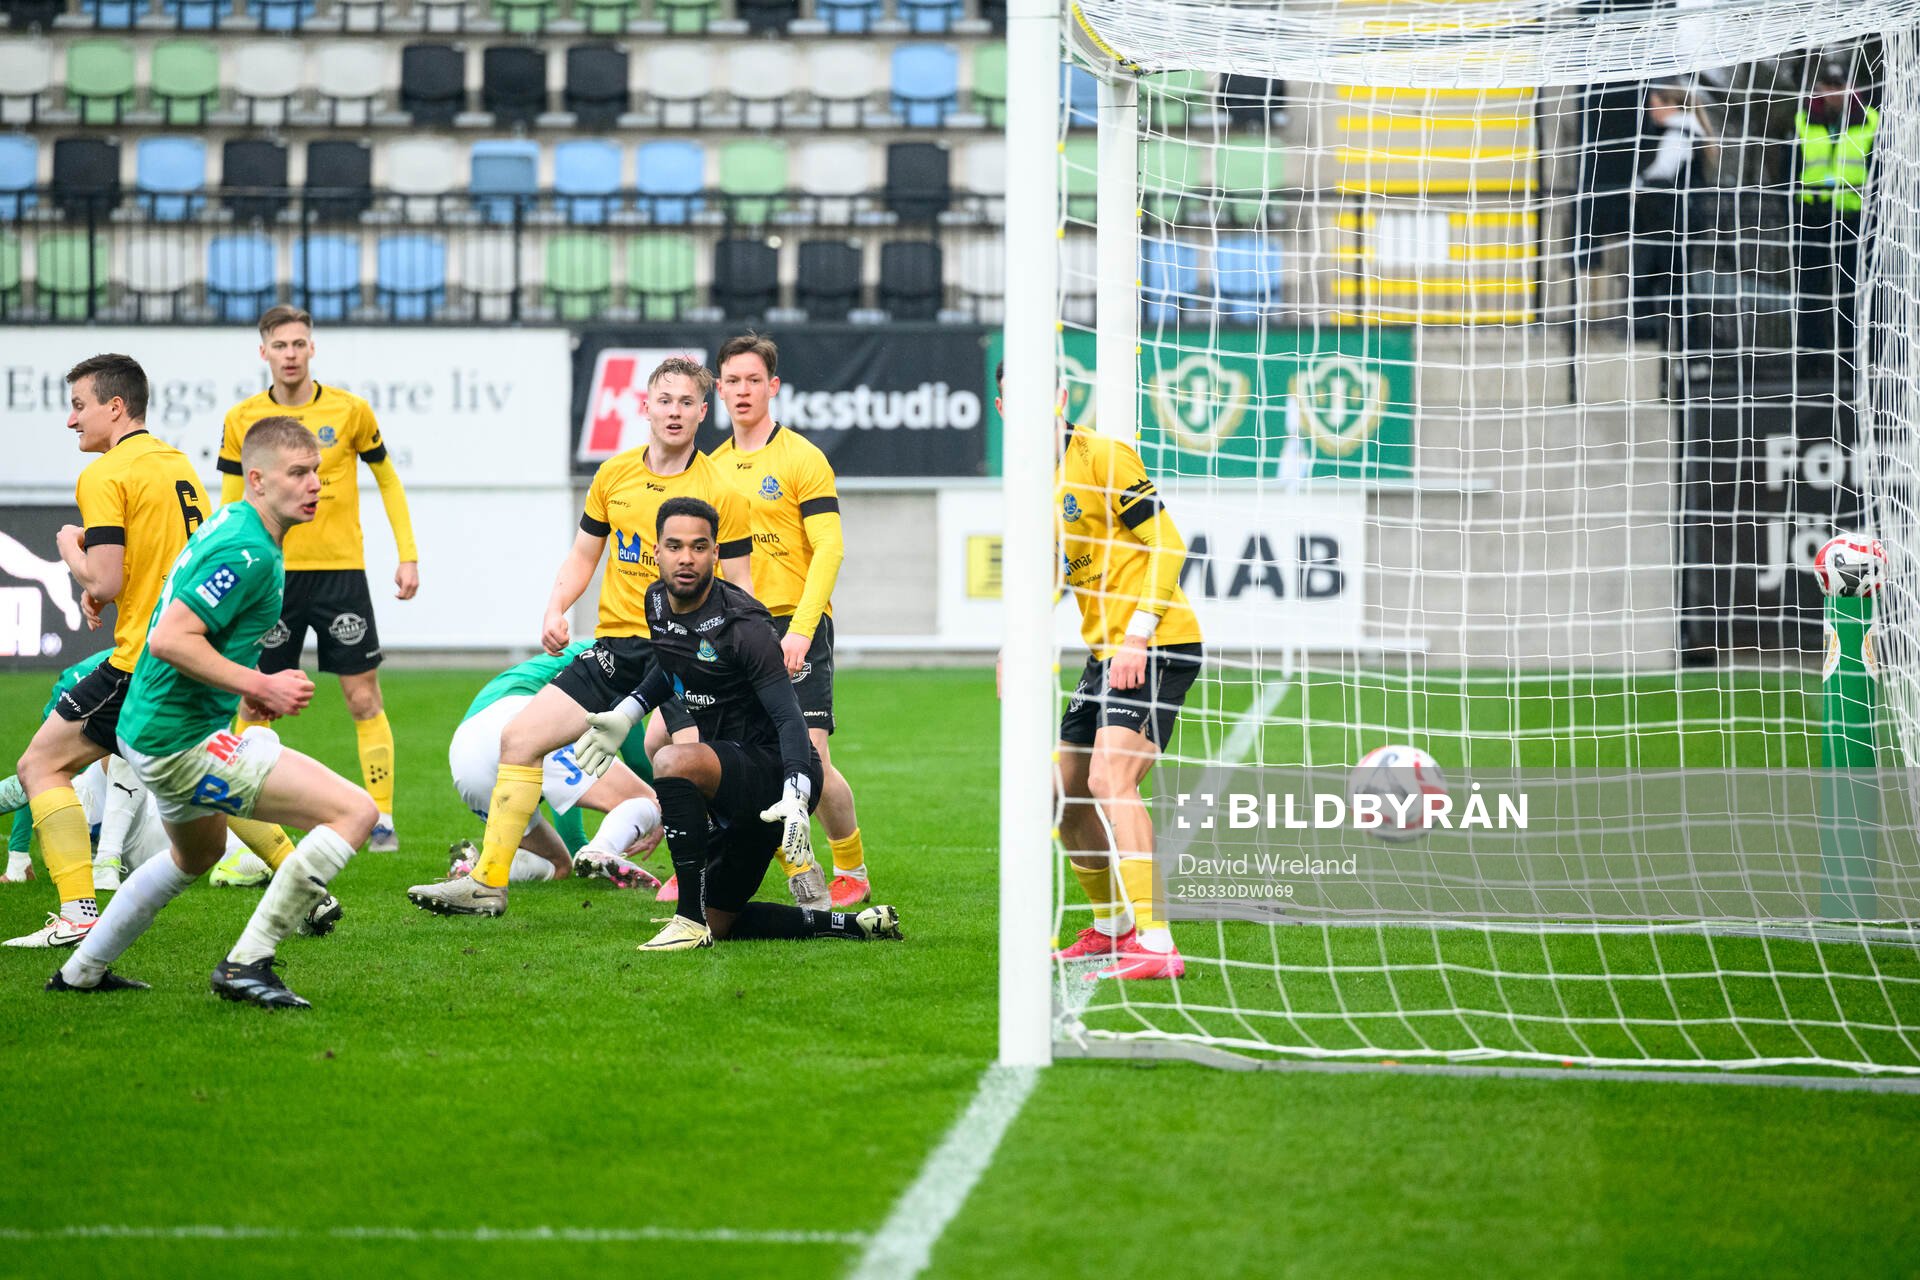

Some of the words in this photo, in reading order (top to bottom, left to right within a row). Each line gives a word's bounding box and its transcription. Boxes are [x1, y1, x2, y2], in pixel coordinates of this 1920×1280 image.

[452, 367, 514, 413] liv
[685, 690, 716, 705] finans
[1106, 707, 1133, 715] CRAFT
